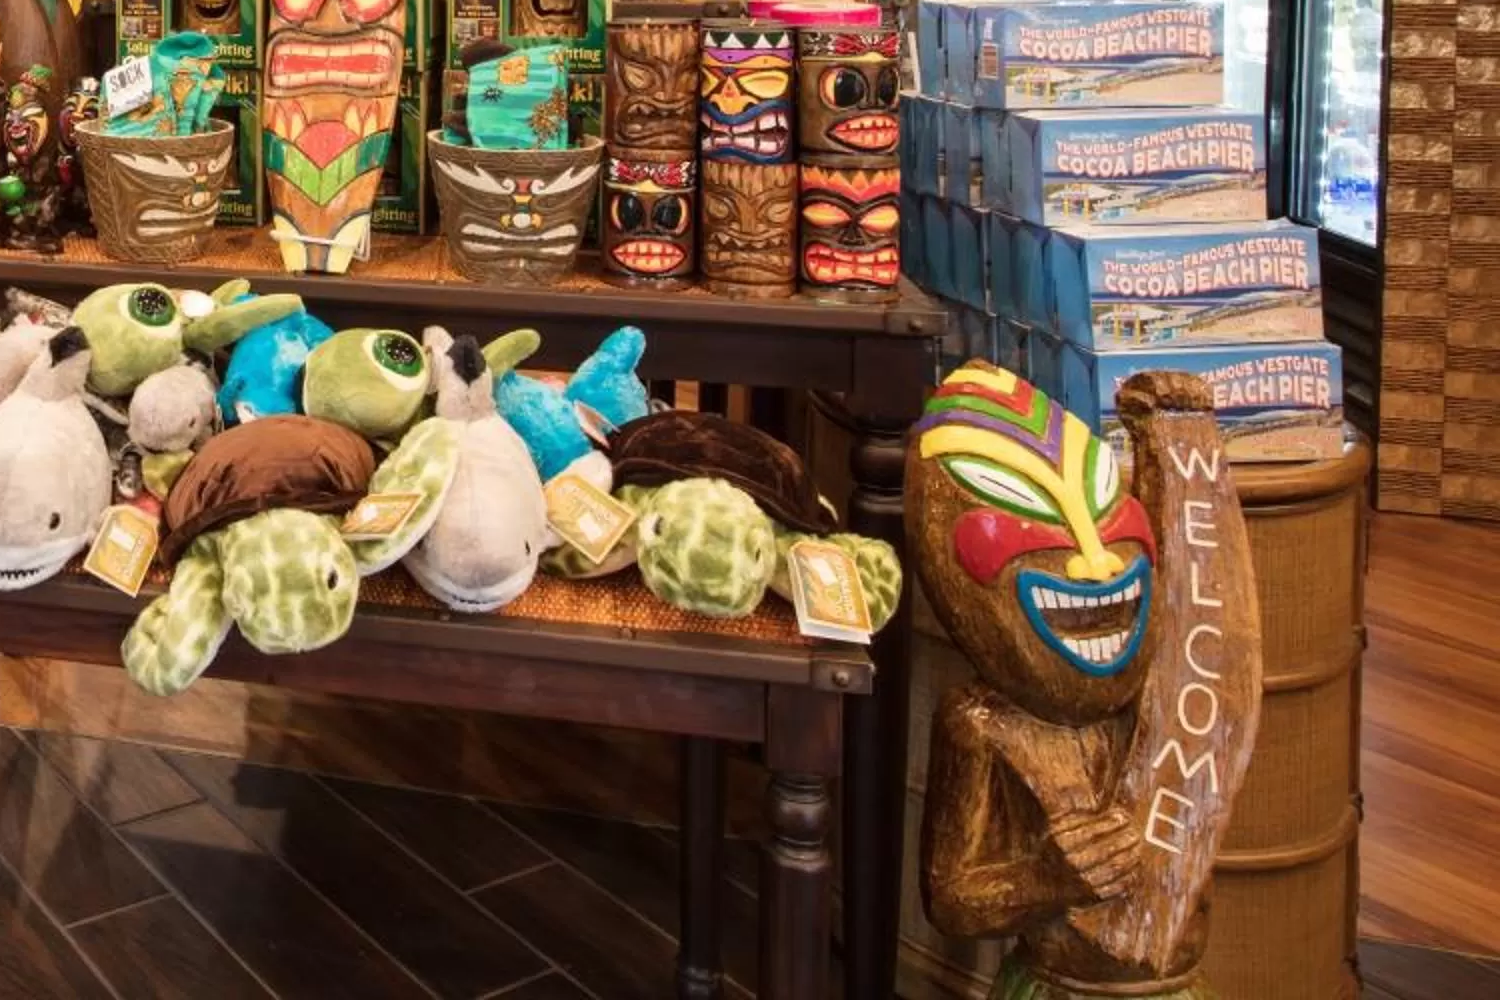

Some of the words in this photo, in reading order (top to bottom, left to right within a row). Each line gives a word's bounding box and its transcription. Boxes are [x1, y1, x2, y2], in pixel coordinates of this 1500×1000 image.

[1020, 27, 1041, 41] THE
[1147, 7, 1210, 27] WESTGATE
[1019, 36, 1088, 61] COCOA
[1092, 28, 1162, 58] BEACH
[1164, 26, 1212, 57] PIER
[1056, 139, 1080, 155] THE
[1185, 121, 1253, 141] WESTGATE
[1057, 154, 1128, 178] COCOA
[1131, 142, 1204, 176] BEACH
[1206, 139, 1255, 173] PIER
[1102, 260, 1127, 274] THE
[1237, 237, 1307, 257] WESTGATE
[1104, 275, 1179, 298] COCOA
[1182, 258, 1256, 296] BEACH
[1258, 258, 1310, 291] PIER
[1254, 356, 1329, 377] WESTGATE
[1212, 378, 1275, 410] EACH
[1278, 374, 1332, 410] PIER
[1145, 444, 1225, 855] WELCOME
